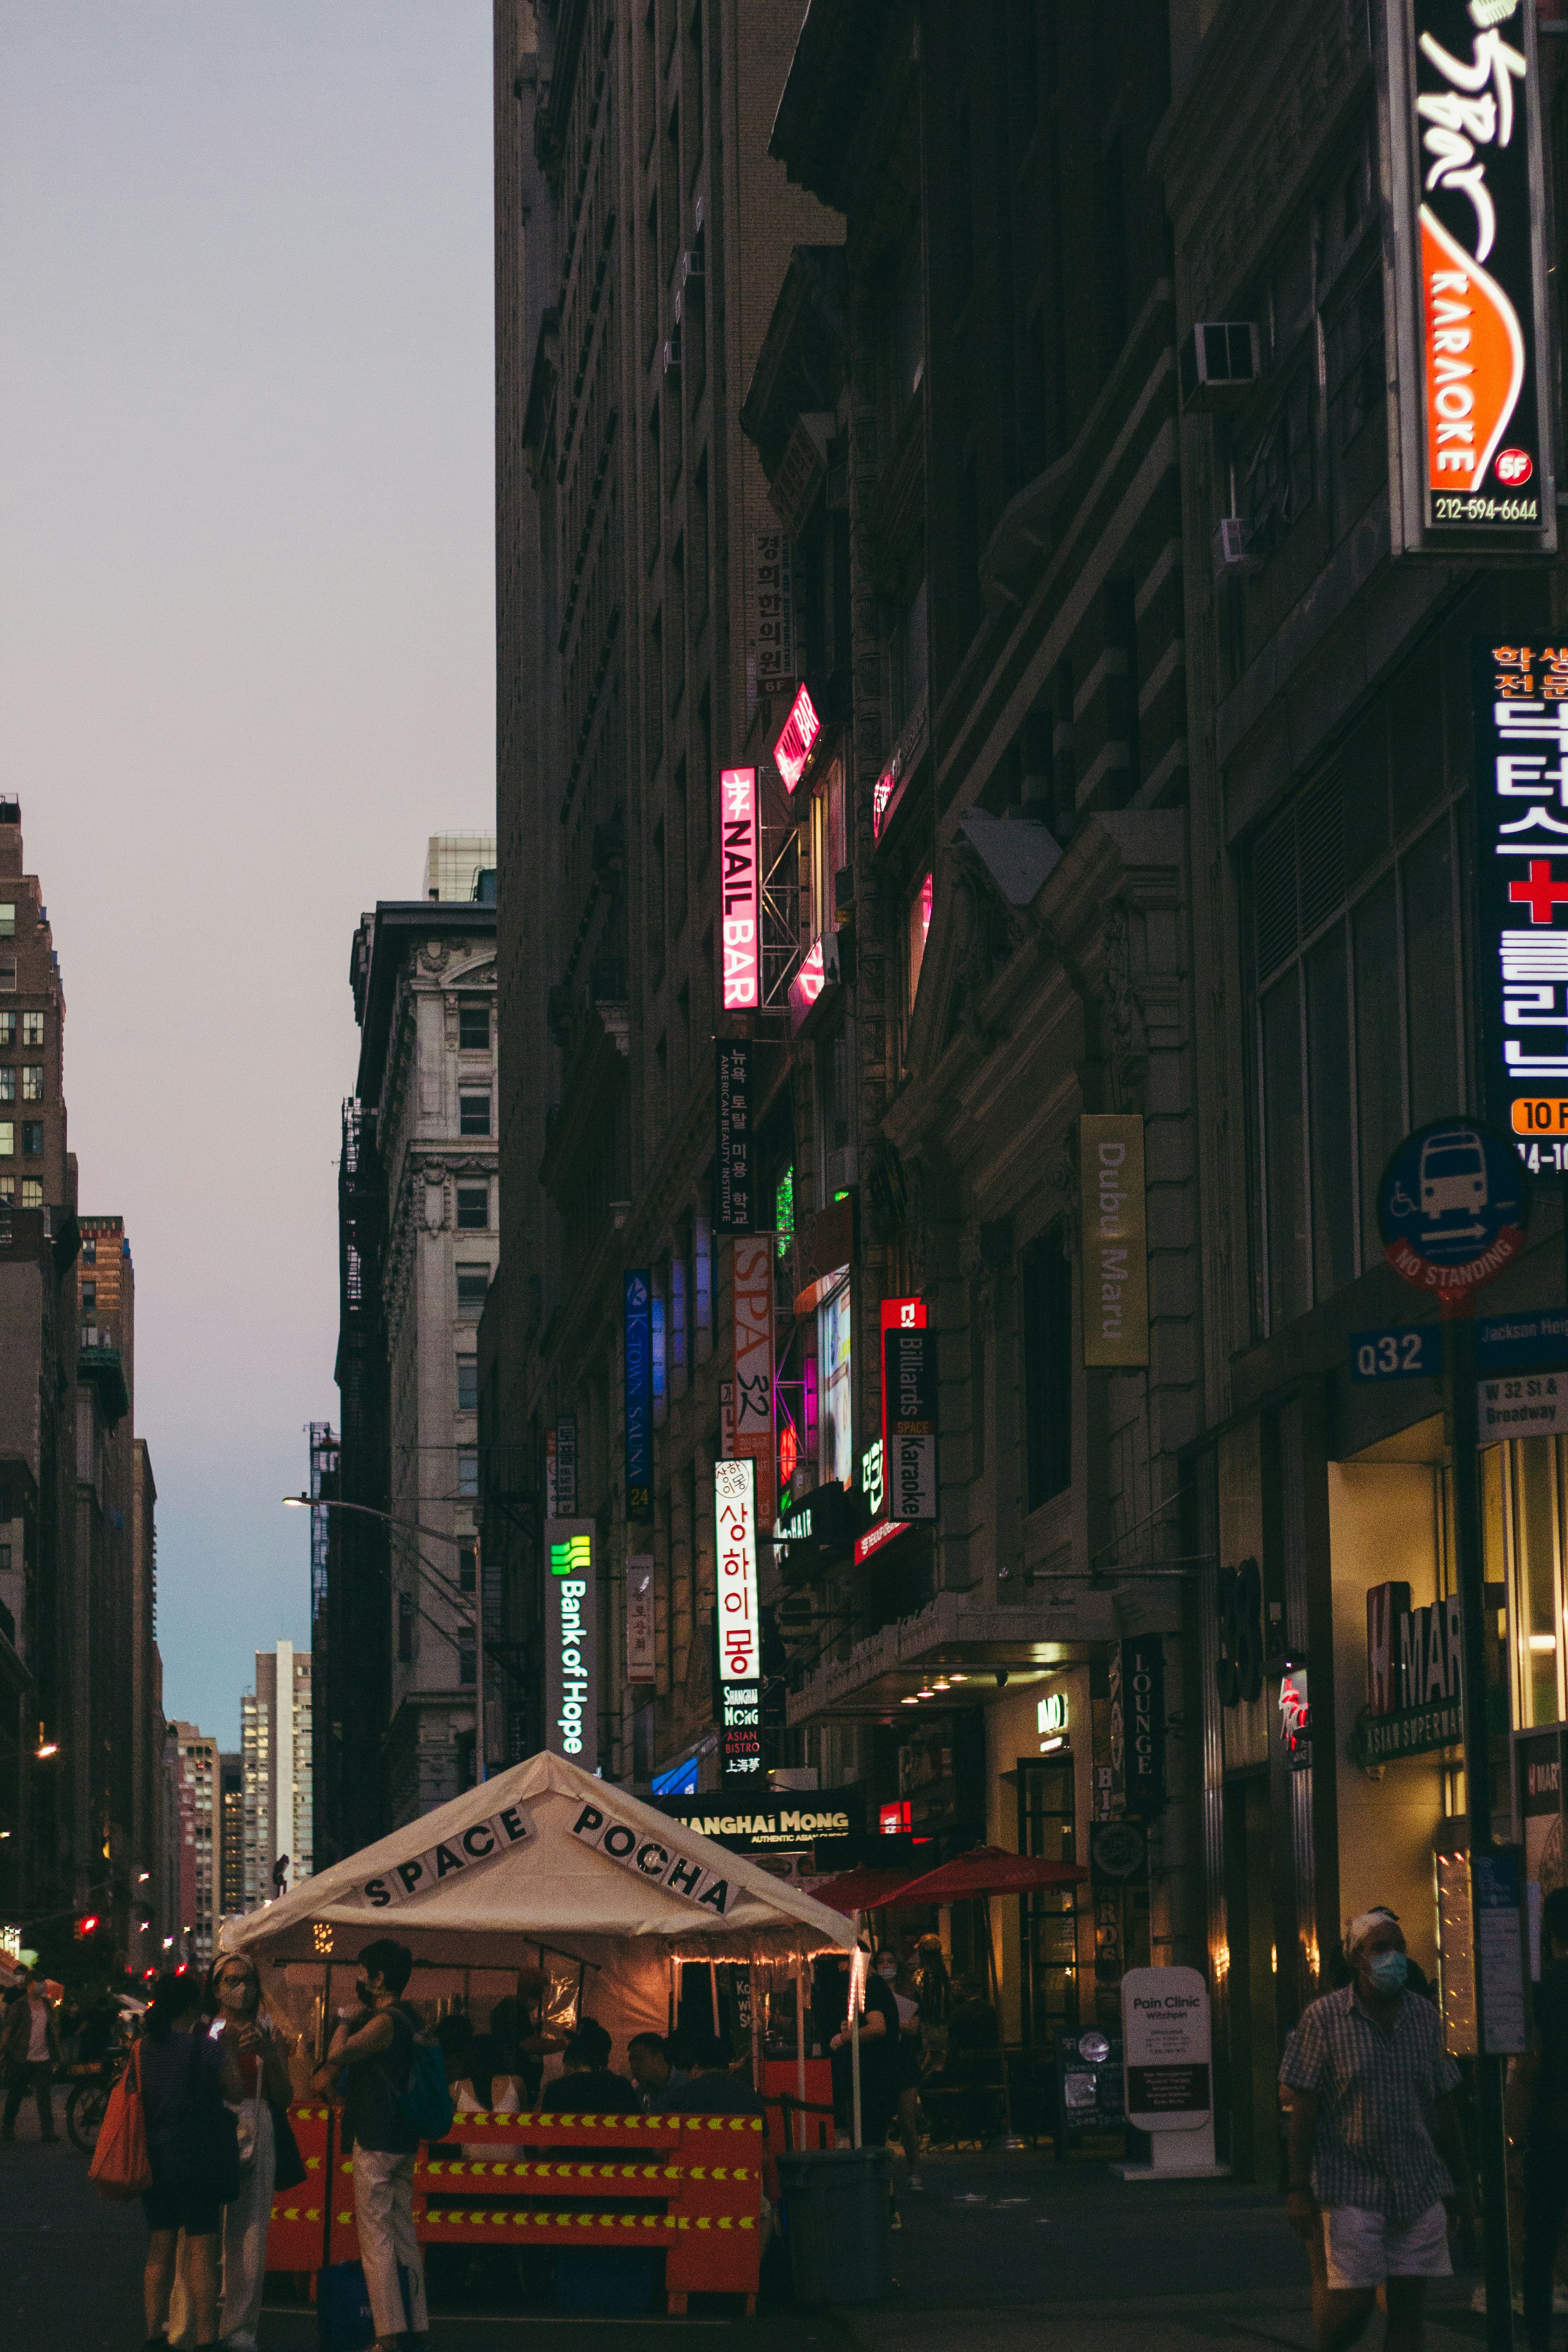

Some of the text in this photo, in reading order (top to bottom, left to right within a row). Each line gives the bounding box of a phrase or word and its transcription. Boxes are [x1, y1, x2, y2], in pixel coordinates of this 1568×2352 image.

[1431, 273, 1475, 473] KARAOKE
[1498, 454, 1527, 480] 5F
[1436, 497, 1538, 521] 212-594-6644
[756, 536, 782, 674] 경희한의원
[1492, 646, 1568, 671] 학생
[1495, 674, 1568, 699] 전문
[765, 681, 786, 693] 6F
[794, 691, 819, 749] BAR
[1494, 702, 1568, 854] 닥터스
[724, 820, 752, 916] NAIL
[723, 919, 754, 1007] BAR
[721, 1055, 731, 1222] AMERICAN BEAUTY INSTITUTE
[730, 1049, 749, 1225] 뉴욕 토탈 미용 학교
[1524, 1102, 1551, 1129] 10
[1099, 1143, 1128, 1338] Dubu Maru
[1396, 1239, 1514, 1287] NO STANDING
[735, 1249, 770, 1357] SPA
[1357, 1333, 1423, 1377] Q32
[1482, 1323, 1537, 1343] Jackson
[627, 1313, 649, 1480] K-TOWN SAUNA
[737, 1370, 770, 1426] 32
[899, 1337, 923, 1416] Billiards
[1486, 1377, 1557, 1401] W 32 St &
[897, 1422, 929, 1435] SPACE
[1487, 1404, 1556, 1425] Broadway
[631, 1489, 649, 1506] 24
[901, 1437, 926, 1516] Karaoke
[720, 1502, 755, 1674] 상하이몽
[558, 1580, 588, 1754] Bank of Hope
[1400, 1593, 1462, 1710] MAR
[727, 1731, 757, 1741] ASIAN
[1133, 1654, 1152, 1774] LOUNGE
[725, 1743, 760, 1753] BISTRO
[726, 1758, 760, 1773] 上海夢
[751, 1833, 794, 1845] AUTHENTIC
[780, 1811, 848, 1832] MONG
[364, 1808, 526, 1908] SPACE
[573, 1805, 728, 1914] POCHA
[1133, 1995, 1200, 2009] Pain Clinic
